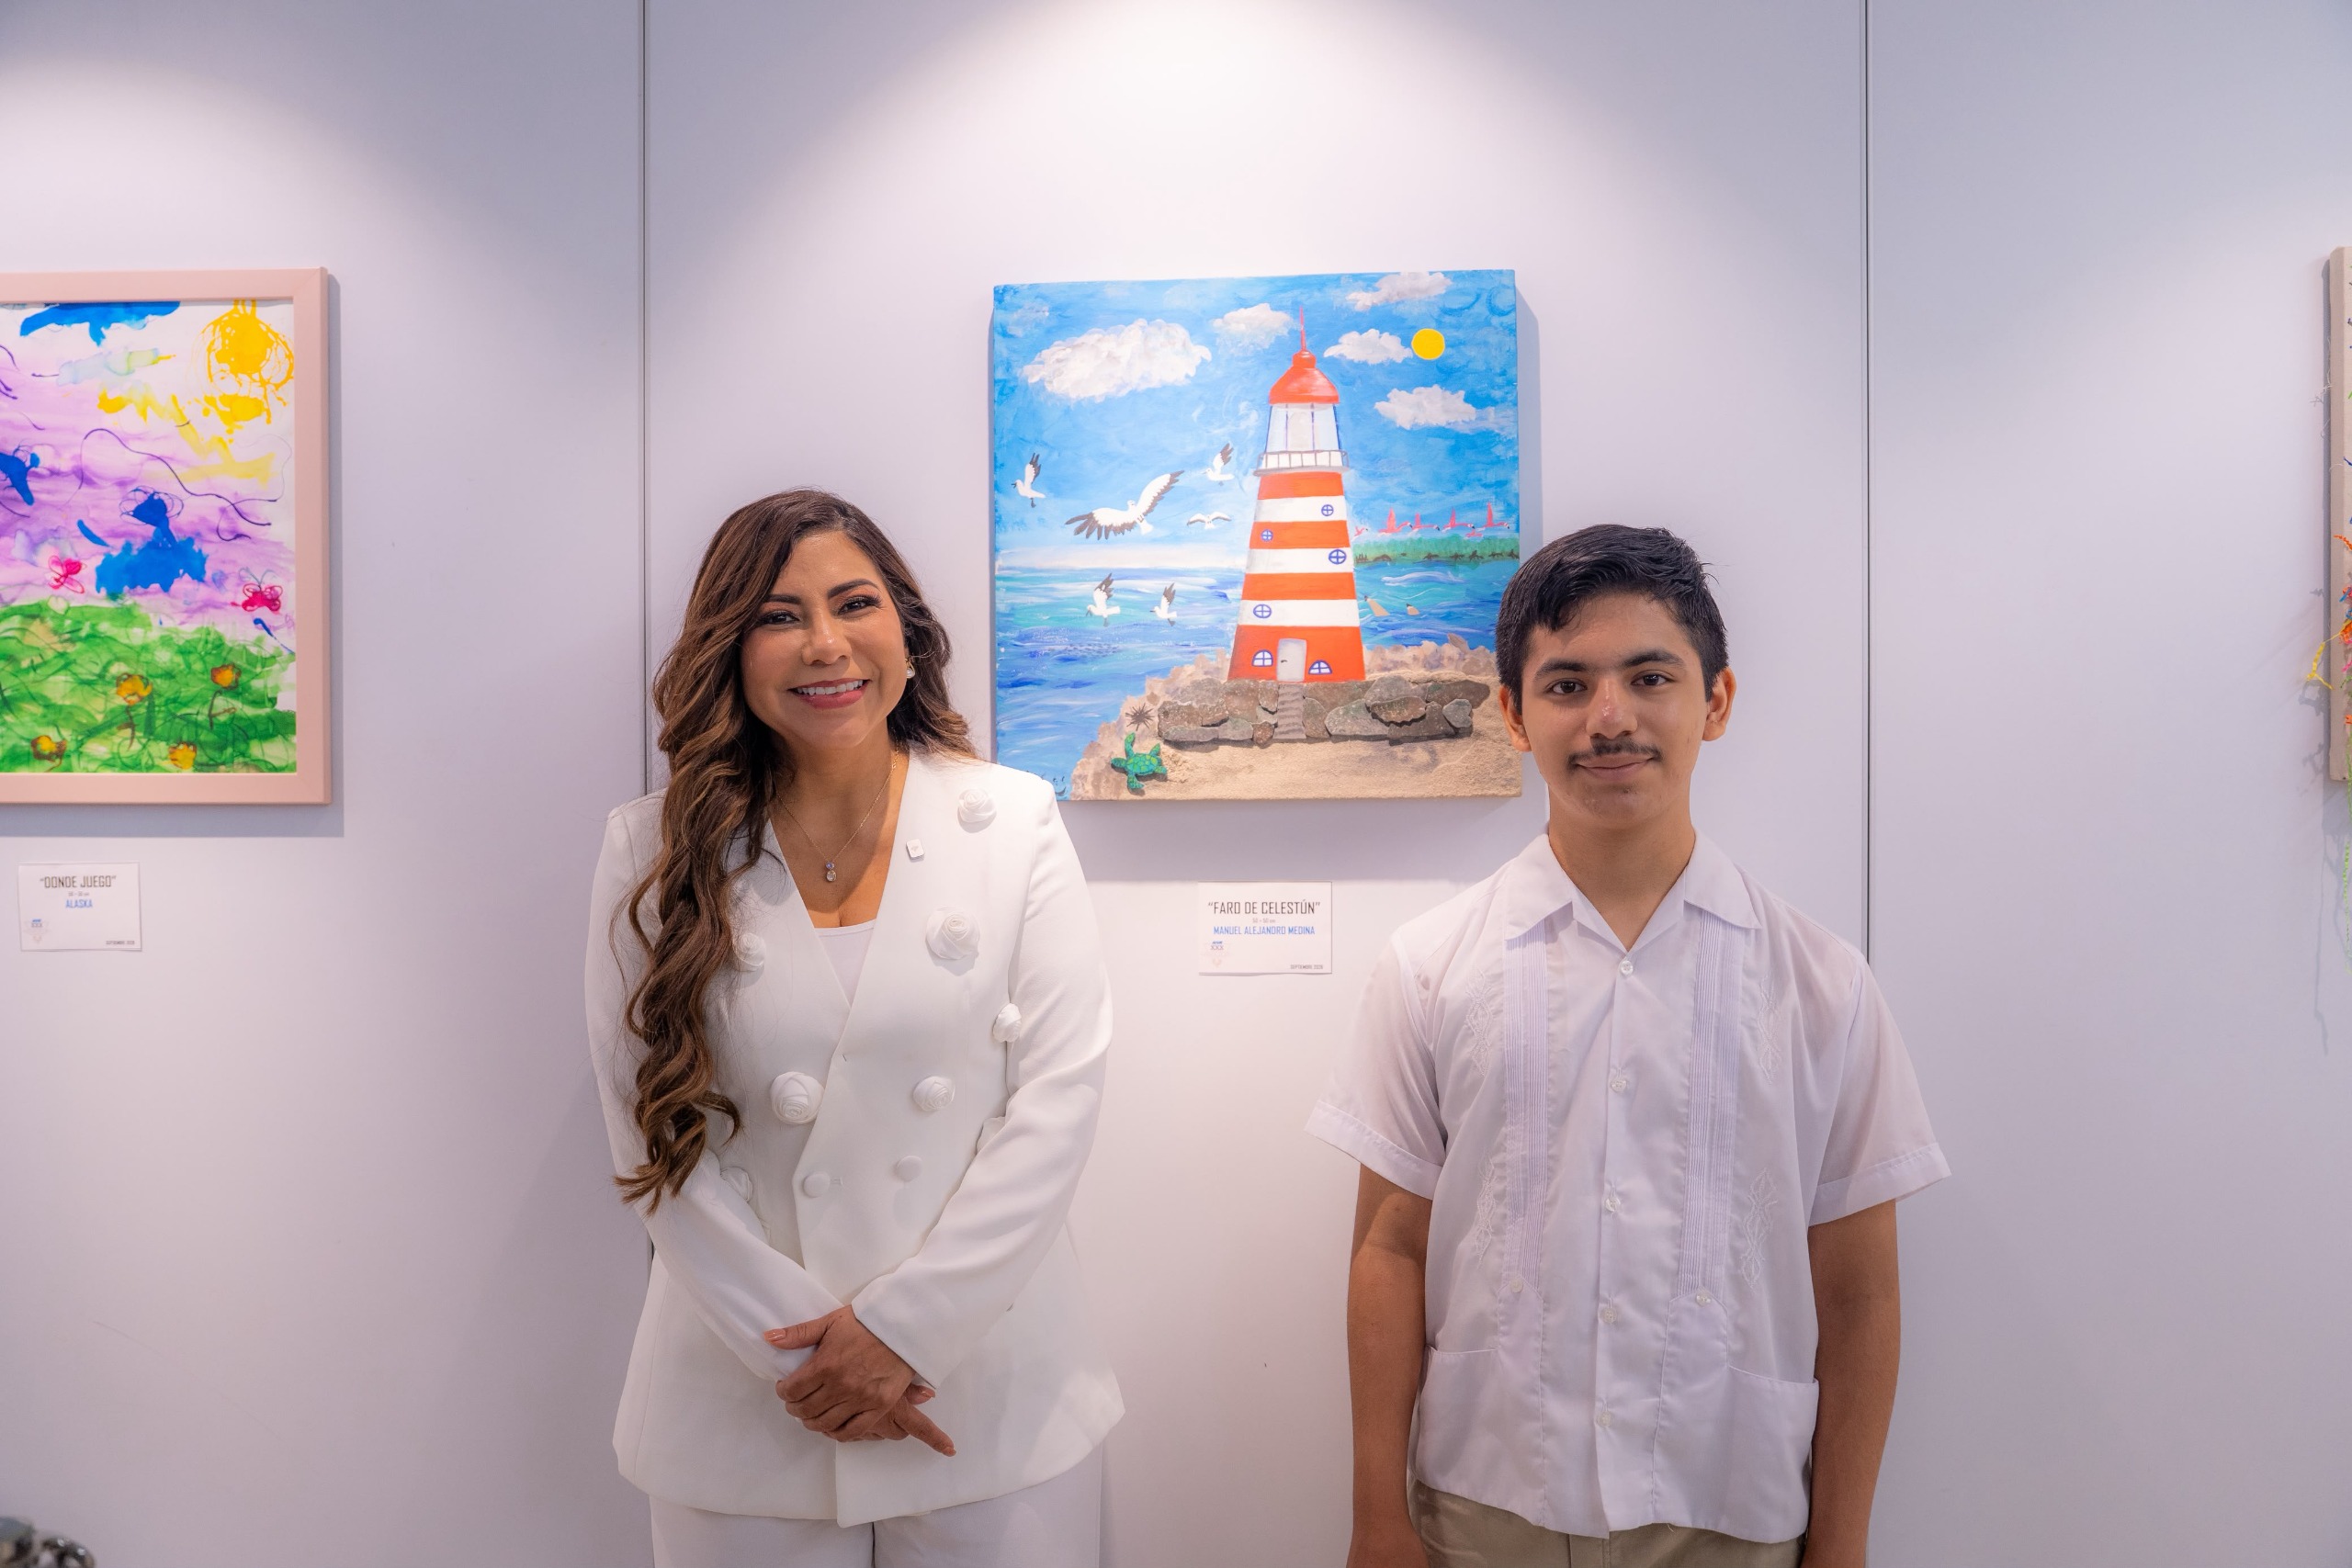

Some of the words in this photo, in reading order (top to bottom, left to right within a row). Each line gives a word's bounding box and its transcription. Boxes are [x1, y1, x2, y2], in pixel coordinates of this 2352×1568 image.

[65, 898, 93, 908] ALASKA
[1244, 901, 1258, 914] DE
[1213, 926, 1241, 935] MANUEL
[1244, 926, 1286, 935] ALEJANDRO
[1288, 926, 1316, 935] MEDINA
